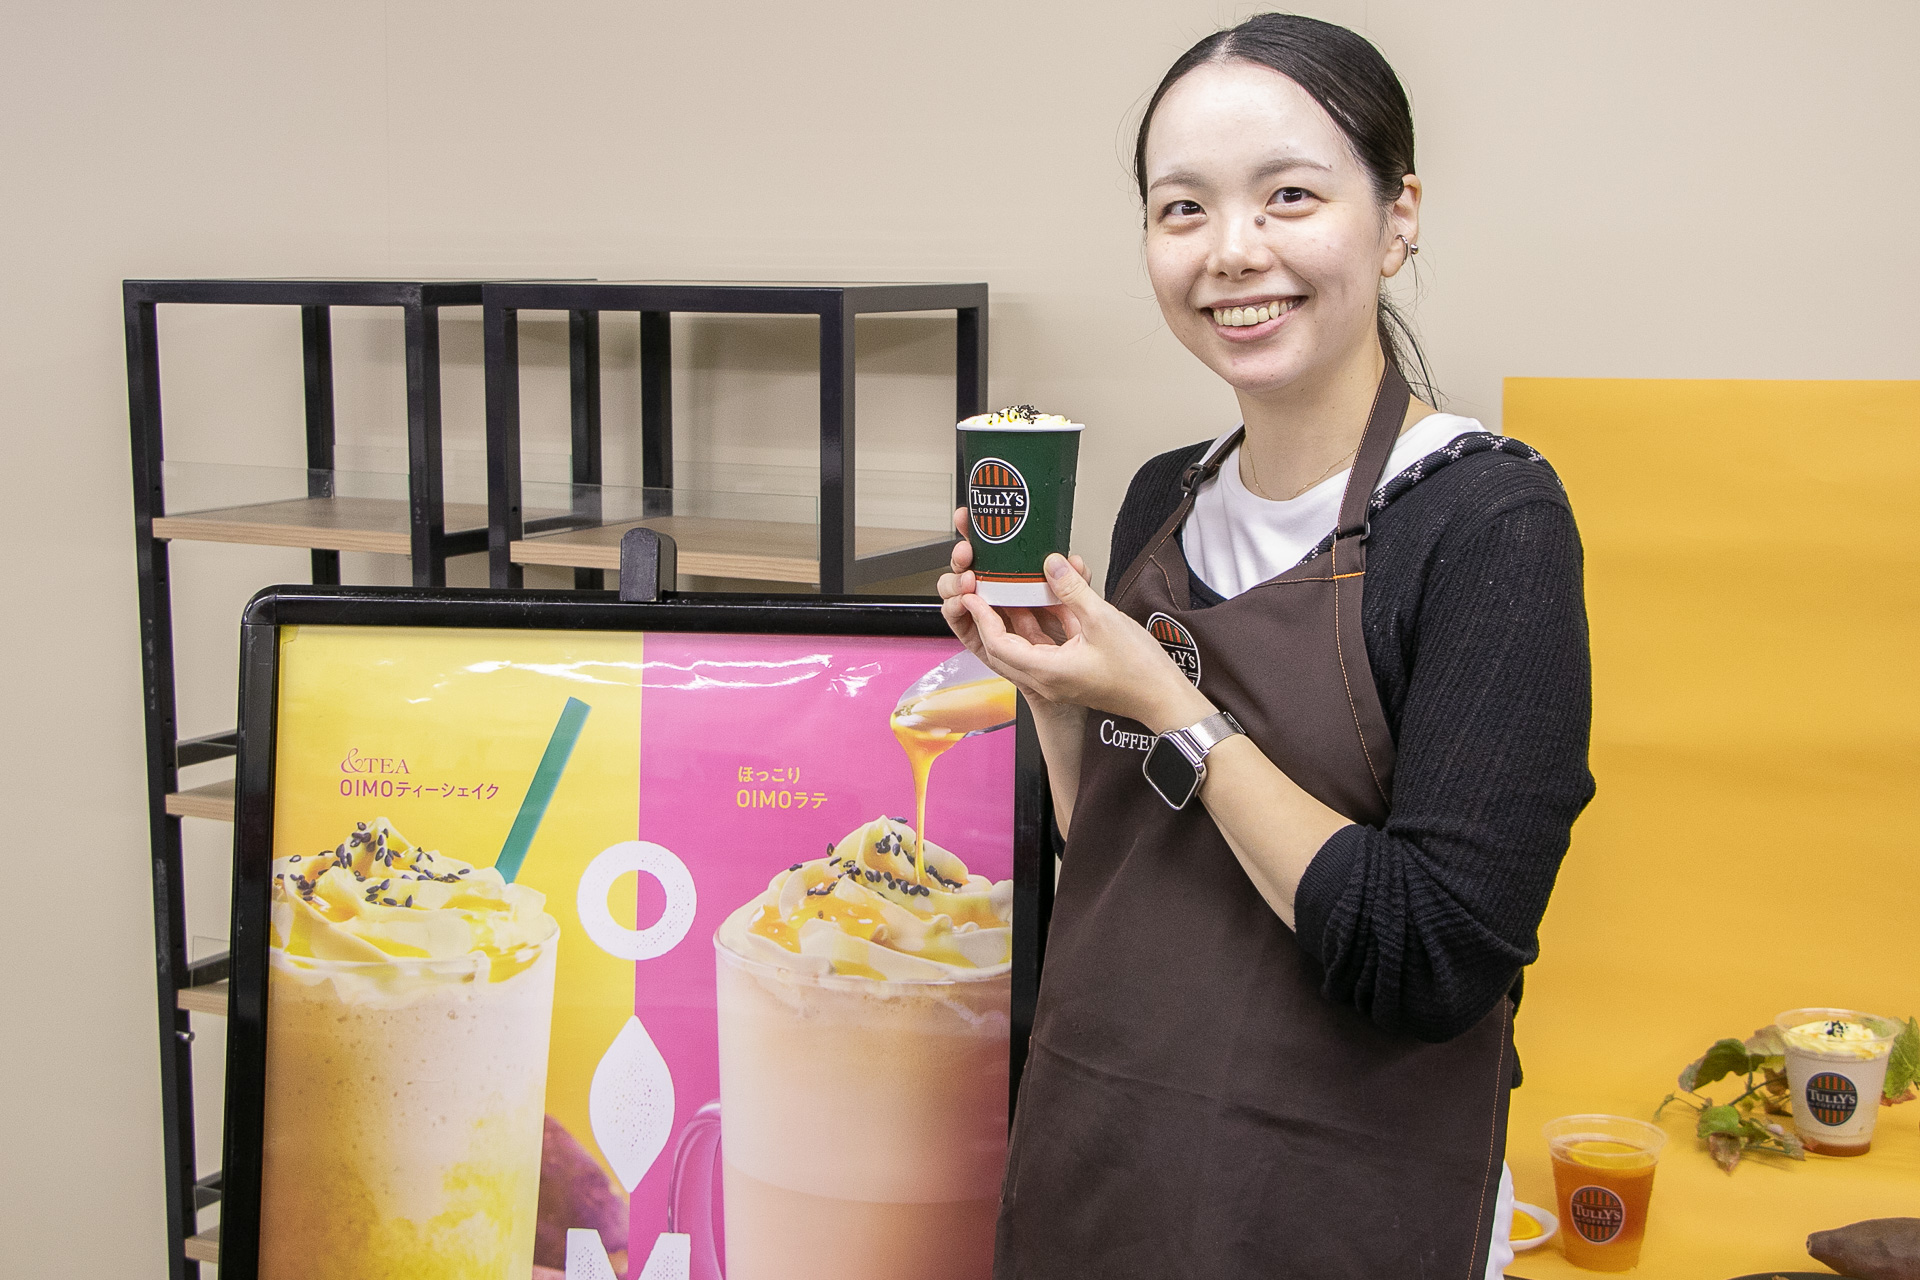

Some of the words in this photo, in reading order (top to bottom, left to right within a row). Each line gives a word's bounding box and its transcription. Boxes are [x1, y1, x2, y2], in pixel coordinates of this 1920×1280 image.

[971, 489, 1025, 507] TULLY'S
[978, 507, 1013, 515] COFFEE
[738, 766, 800, 784] ほっこり
[340, 779, 499, 800] OIMOティーシェイク
[736, 789, 828, 809] OIMOラテ
[1808, 1089, 1856, 1105] TULLY'S
[1573, 1203, 1621, 1220] TULLY'S
